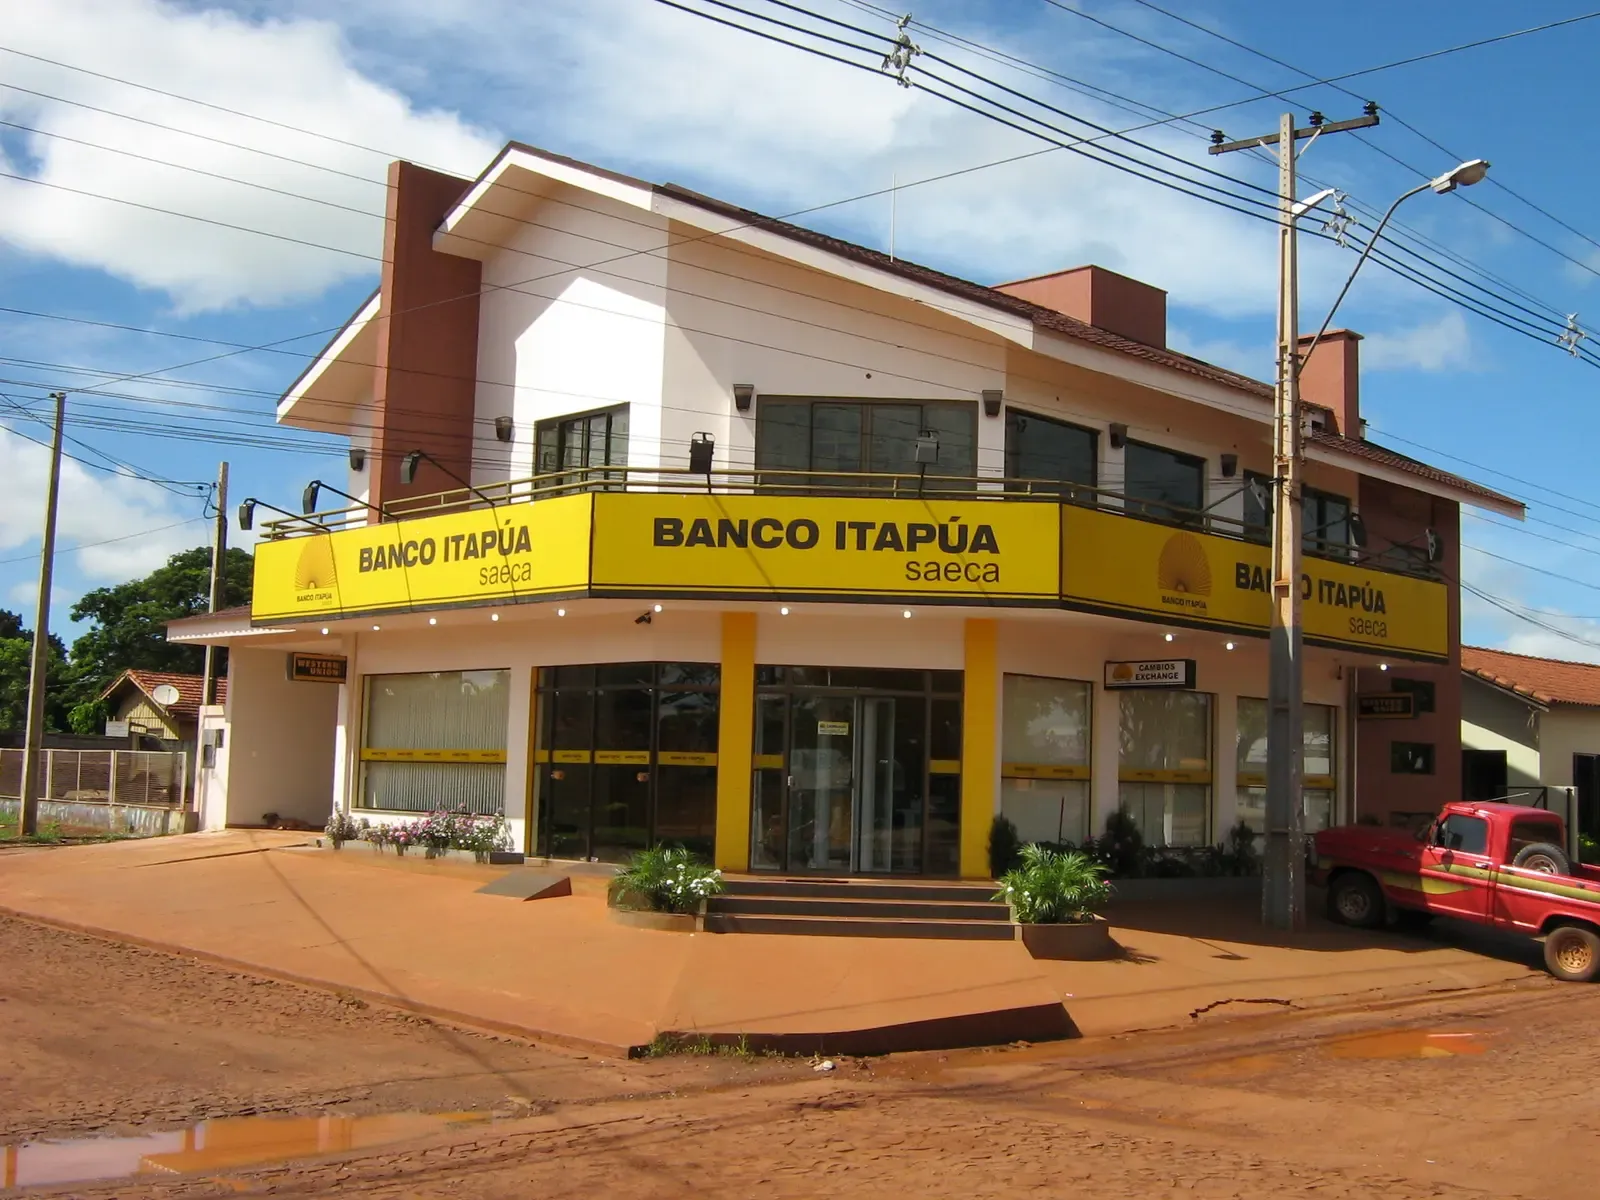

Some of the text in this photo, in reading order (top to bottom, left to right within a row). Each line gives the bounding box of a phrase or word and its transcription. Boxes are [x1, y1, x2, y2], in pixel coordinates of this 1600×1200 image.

[359, 519, 532, 573] BANCO ITAPÚA
[653, 516, 1000, 554] BANCO ITAPÚA
[479, 562, 532, 586] saeca
[905, 561, 1000, 583] saeca
[1235, 562, 1386, 614] BAO ITAPÚA
[1350, 616, 1387, 638] saeca
[310, 667, 338, 676] UNION
[1135, 672, 1179, 681] EXCHANGE
[1139, 663, 1175, 671] CAMBIOS
